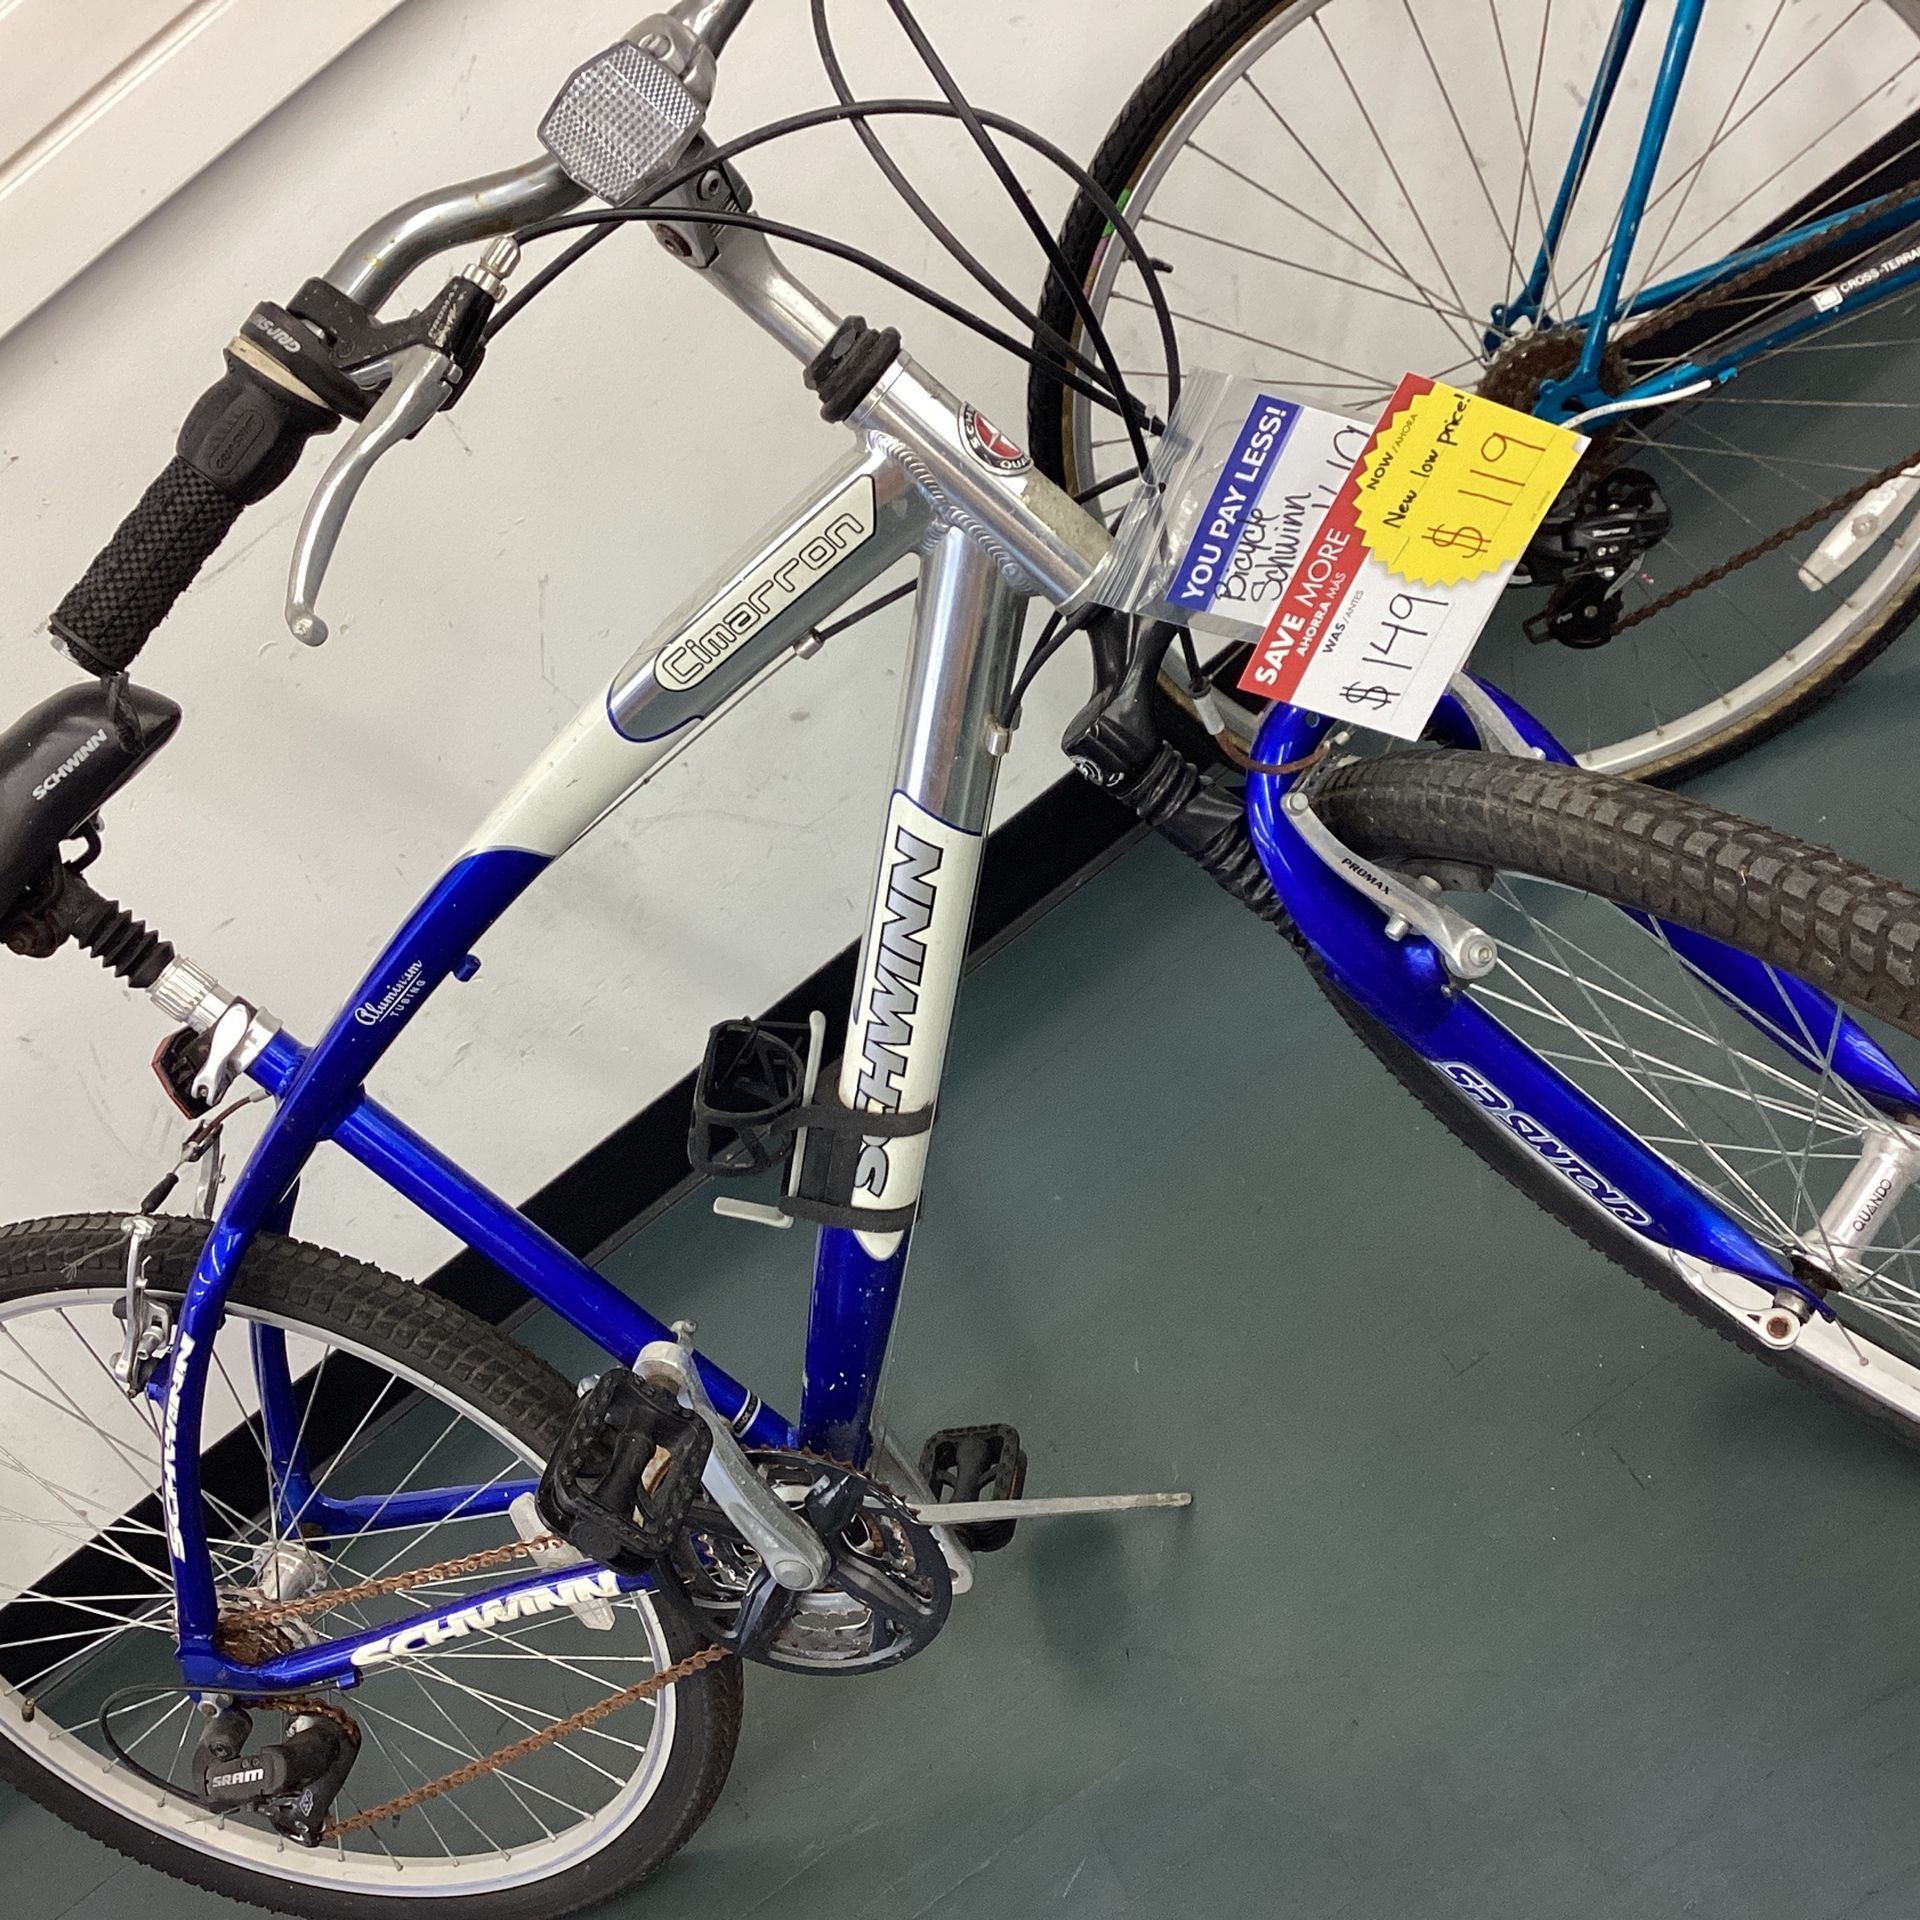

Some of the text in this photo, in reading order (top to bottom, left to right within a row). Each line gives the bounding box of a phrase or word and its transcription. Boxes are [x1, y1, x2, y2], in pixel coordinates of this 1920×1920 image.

[1181, 406, 1287, 599] YOU PAY LESS!
[1383, 393, 1471, 529] New low price!
[1251, 492, 1312, 602] Schwinn
[662, 513, 864, 684] Cimarron
[1255, 613, 1306, 686] SAVE
[1295, 528, 1350, 607] MORE
[1296, 571, 1347, 657] AHORRA MÁS
[32, 728, 108, 800] SCHWINN
[1341, 857, 1392, 895] PROMAX
[389, 979, 426, 1017] TUBING
[1444, 1061, 1651, 1225] SR SUNTOUR
[1853, 1179, 1892, 1231] QUANDO
[351, 1569, 621, 1666] SCHWINN
[212, 1768, 264, 1788] SRAM
